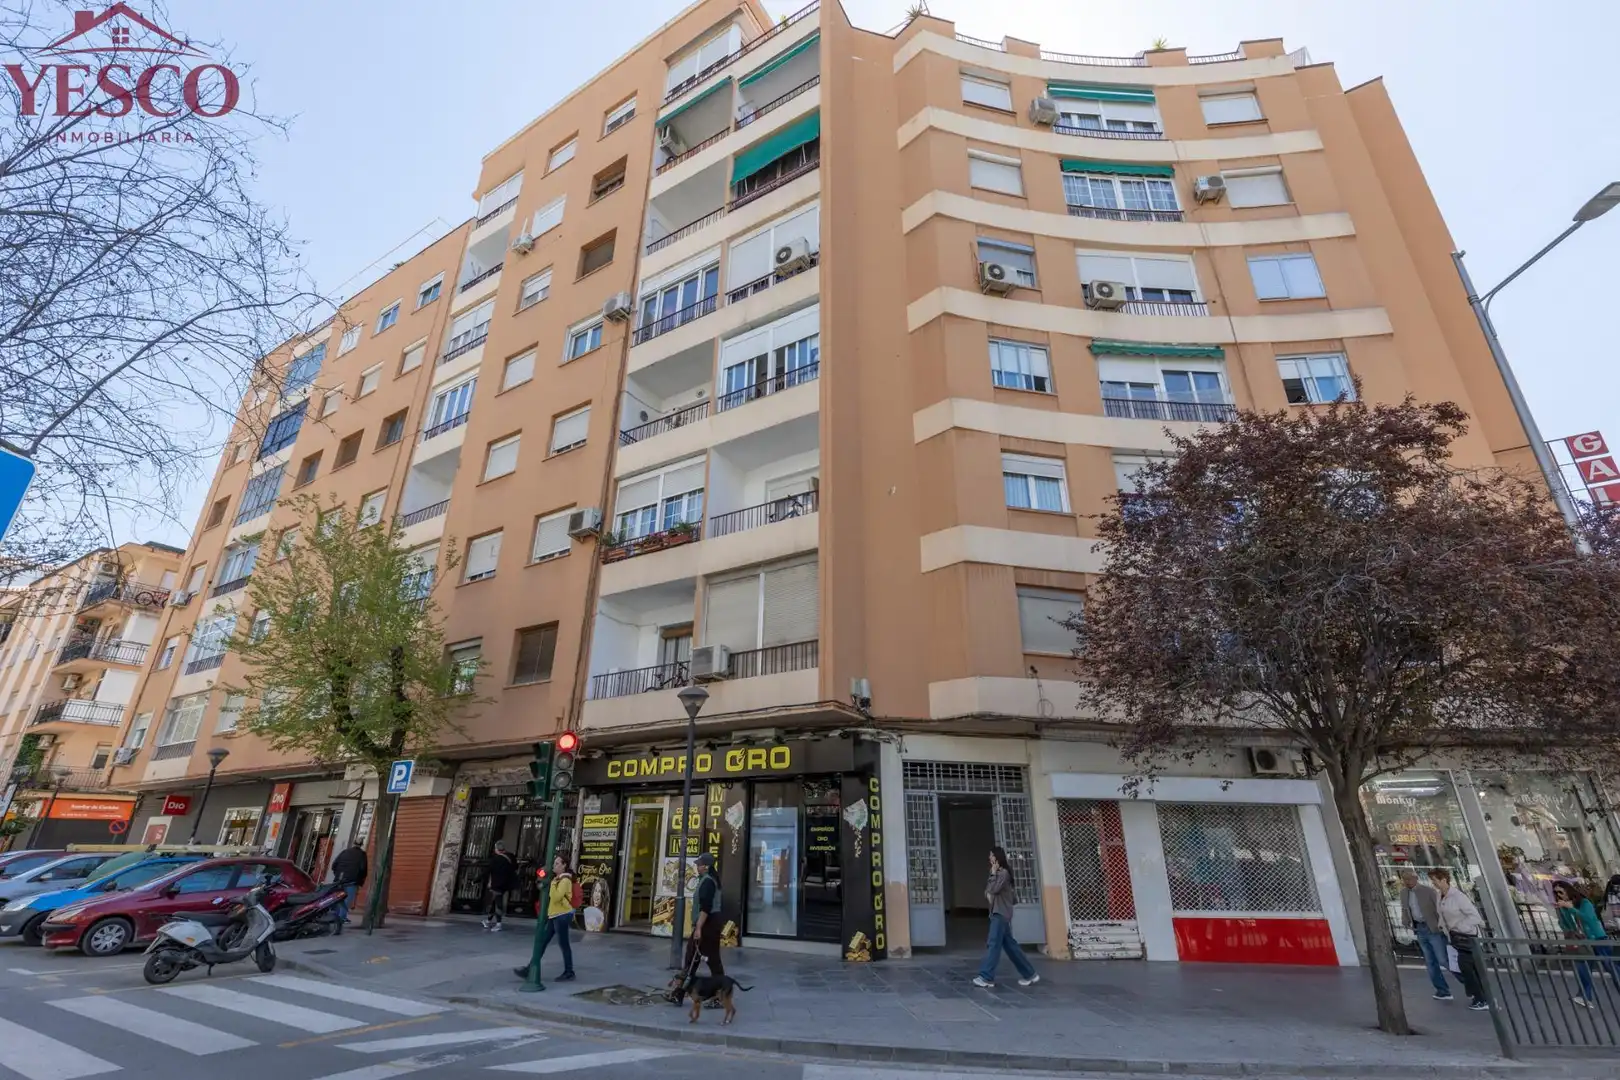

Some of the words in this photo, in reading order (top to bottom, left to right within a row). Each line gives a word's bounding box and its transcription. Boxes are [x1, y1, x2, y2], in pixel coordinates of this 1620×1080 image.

[391, 764, 407, 790] P
[607, 753, 713, 778] COMPRO
[725, 747, 791, 772] ORO
[869, 777, 883, 887] COMPRO
